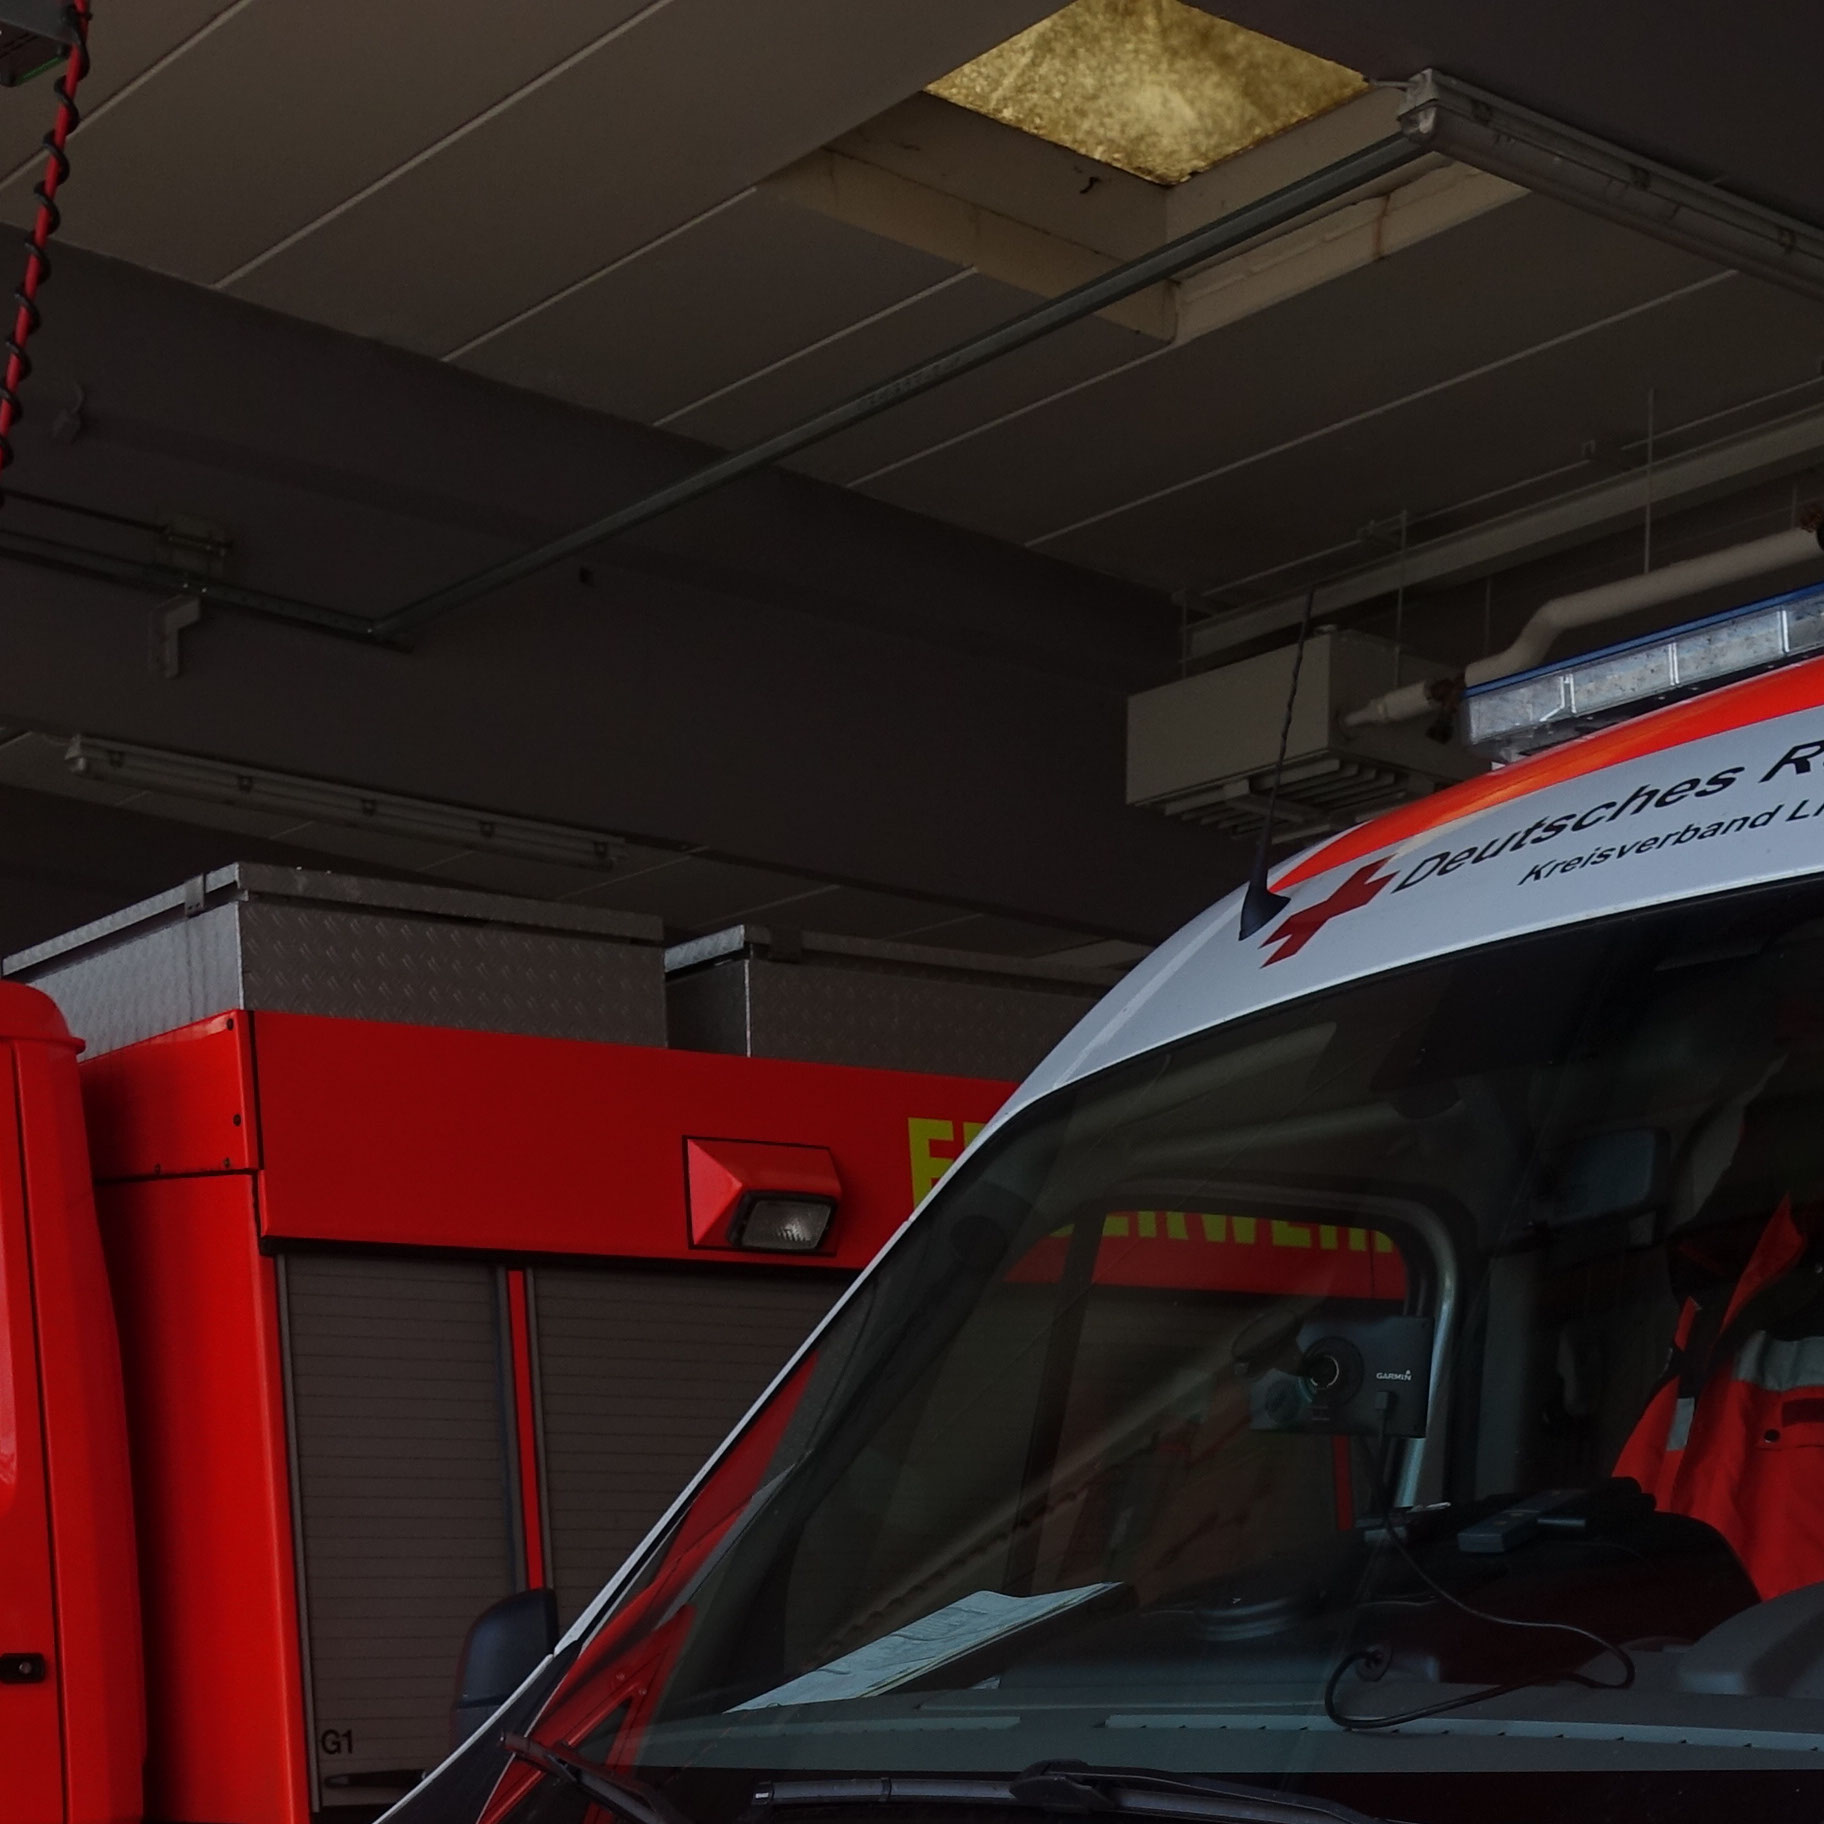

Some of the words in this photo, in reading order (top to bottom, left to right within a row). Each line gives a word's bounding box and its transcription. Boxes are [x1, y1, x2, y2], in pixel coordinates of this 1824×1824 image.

[1391, 763, 1741, 895] Deutsches
[1516, 808, 1782, 887] Kreisverband
[1376, 1370, 1413, 1382] GARMIN
[321, 1730, 354, 1754] G1
